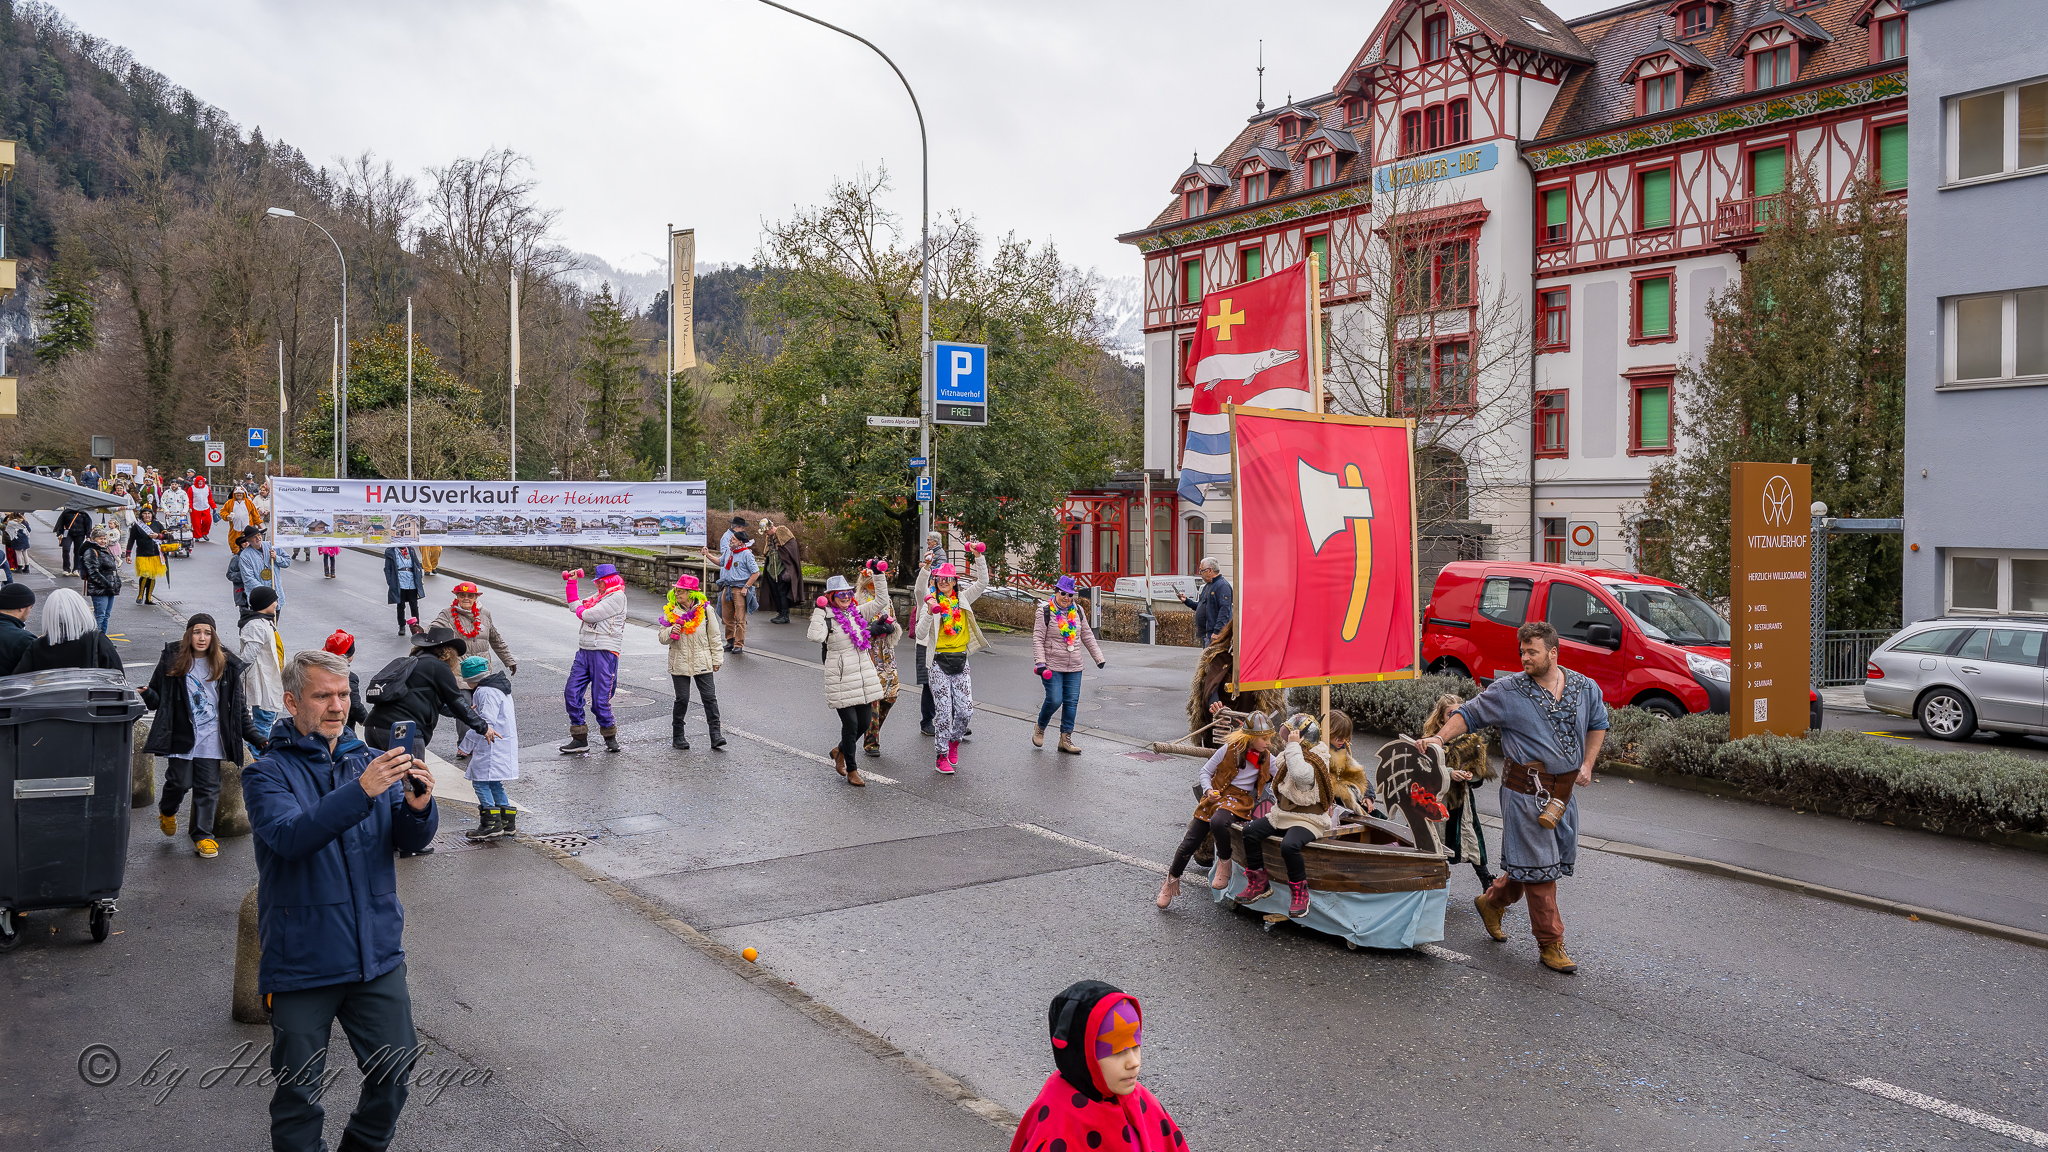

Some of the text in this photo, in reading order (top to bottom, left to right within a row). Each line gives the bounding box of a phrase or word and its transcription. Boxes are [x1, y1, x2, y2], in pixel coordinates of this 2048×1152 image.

[1389, 158, 1448, 188] VTZNAUER
[1460, 150, 1482, 173] HOF
[950, 350, 973, 388] P
[940, 388, 981, 399] Vitznauerhof
[950, 407, 972, 417] FREI
[920, 477, 929, 490] P
[365, 485, 634, 505] HAUSverkauf der Heimat
[1747, 535, 1807, 548] VITZNAUERHOF
[1748, 571, 1807, 581] HERZLICH WILLKOMMEN
[1754, 604, 1768, 612] HOTEL
[1754, 622, 1783, 631] RESTAURANTS
[1753, 642, 1763, 650] BAR
[1753, 661, 1762, 669] SPA
[1753, 679, 1773, 688] SEMINAR
